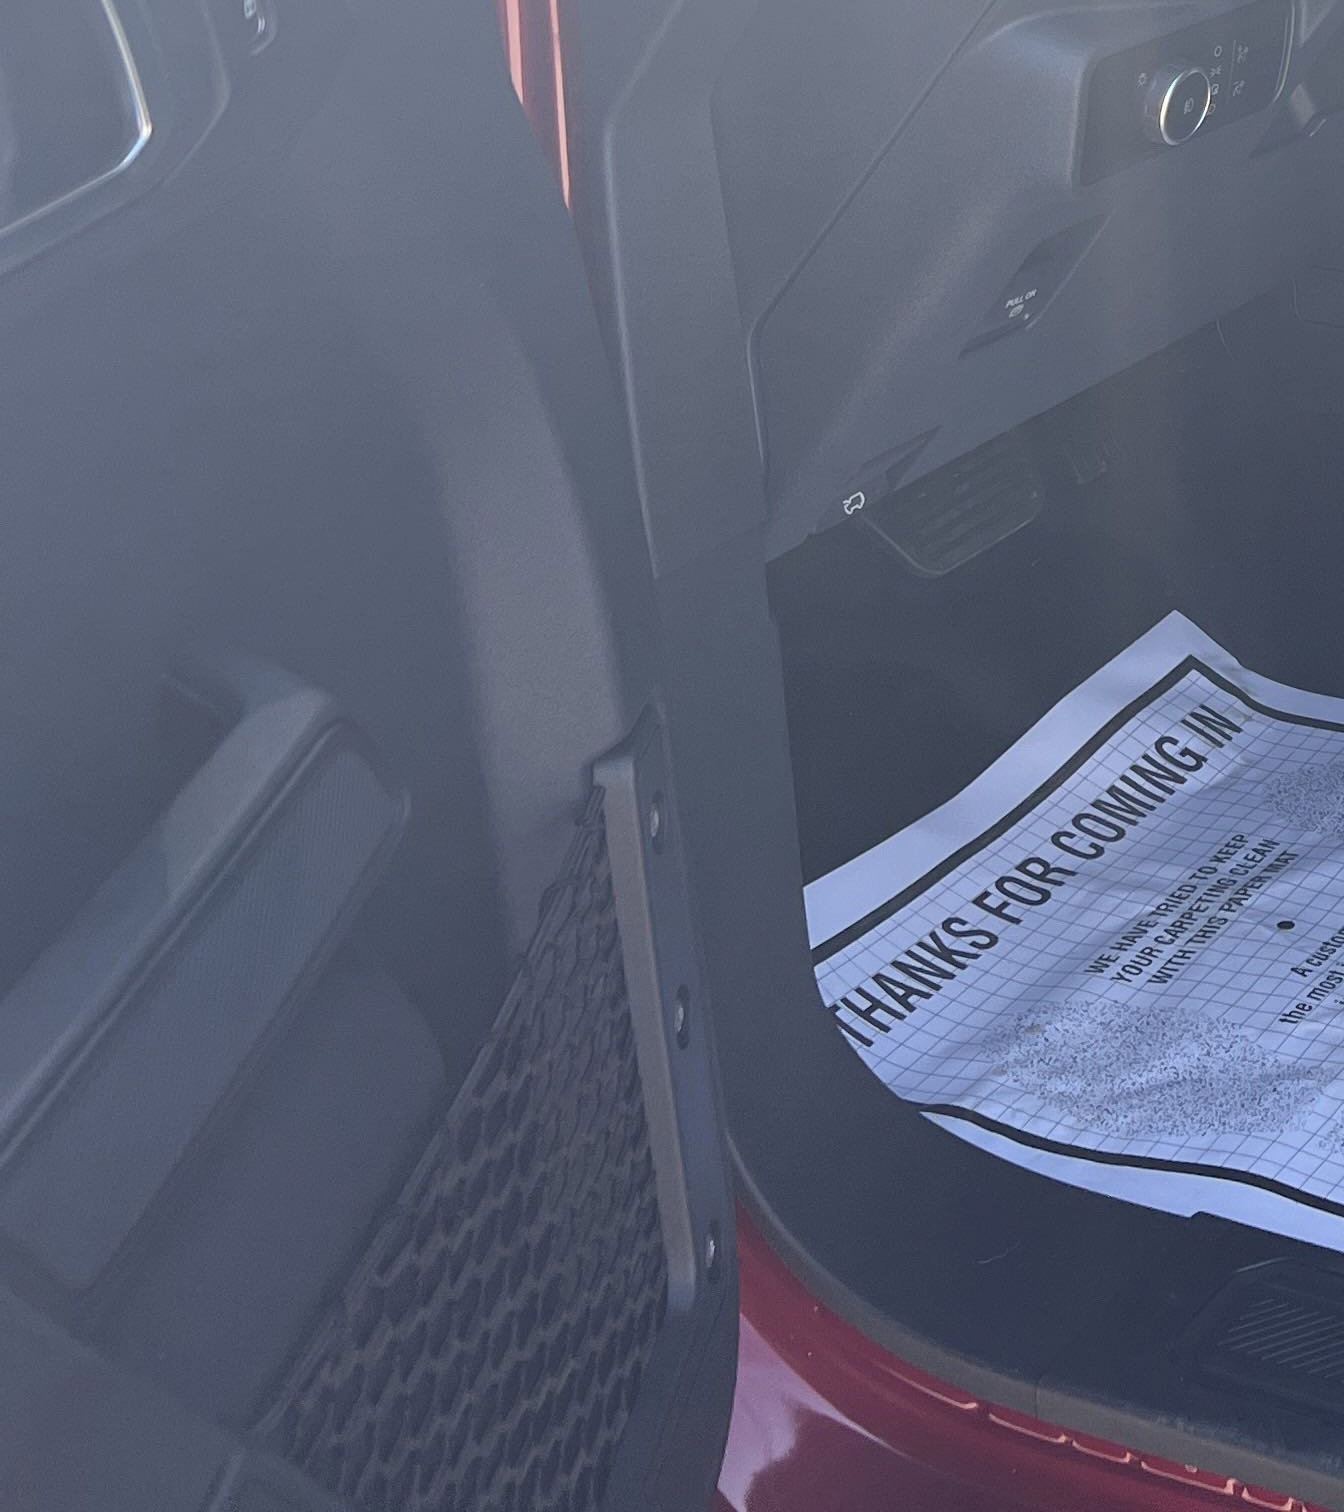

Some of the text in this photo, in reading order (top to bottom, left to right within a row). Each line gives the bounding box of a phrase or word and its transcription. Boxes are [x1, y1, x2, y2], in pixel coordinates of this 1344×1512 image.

[833, 704, 1243, 1048] THANKS FOR COMING IN
[1084, 834, 1249, 975] WE HAVE TRIED TO KEEP
[1110, 838, 1281, 984] YOUR CARPETING CLEAN
[1147, 850, 1299, 985] WITH THIS PAPER MAT
[1279, 1002, 1313, 1024] the
[1290, 966, 1313, 978] A
